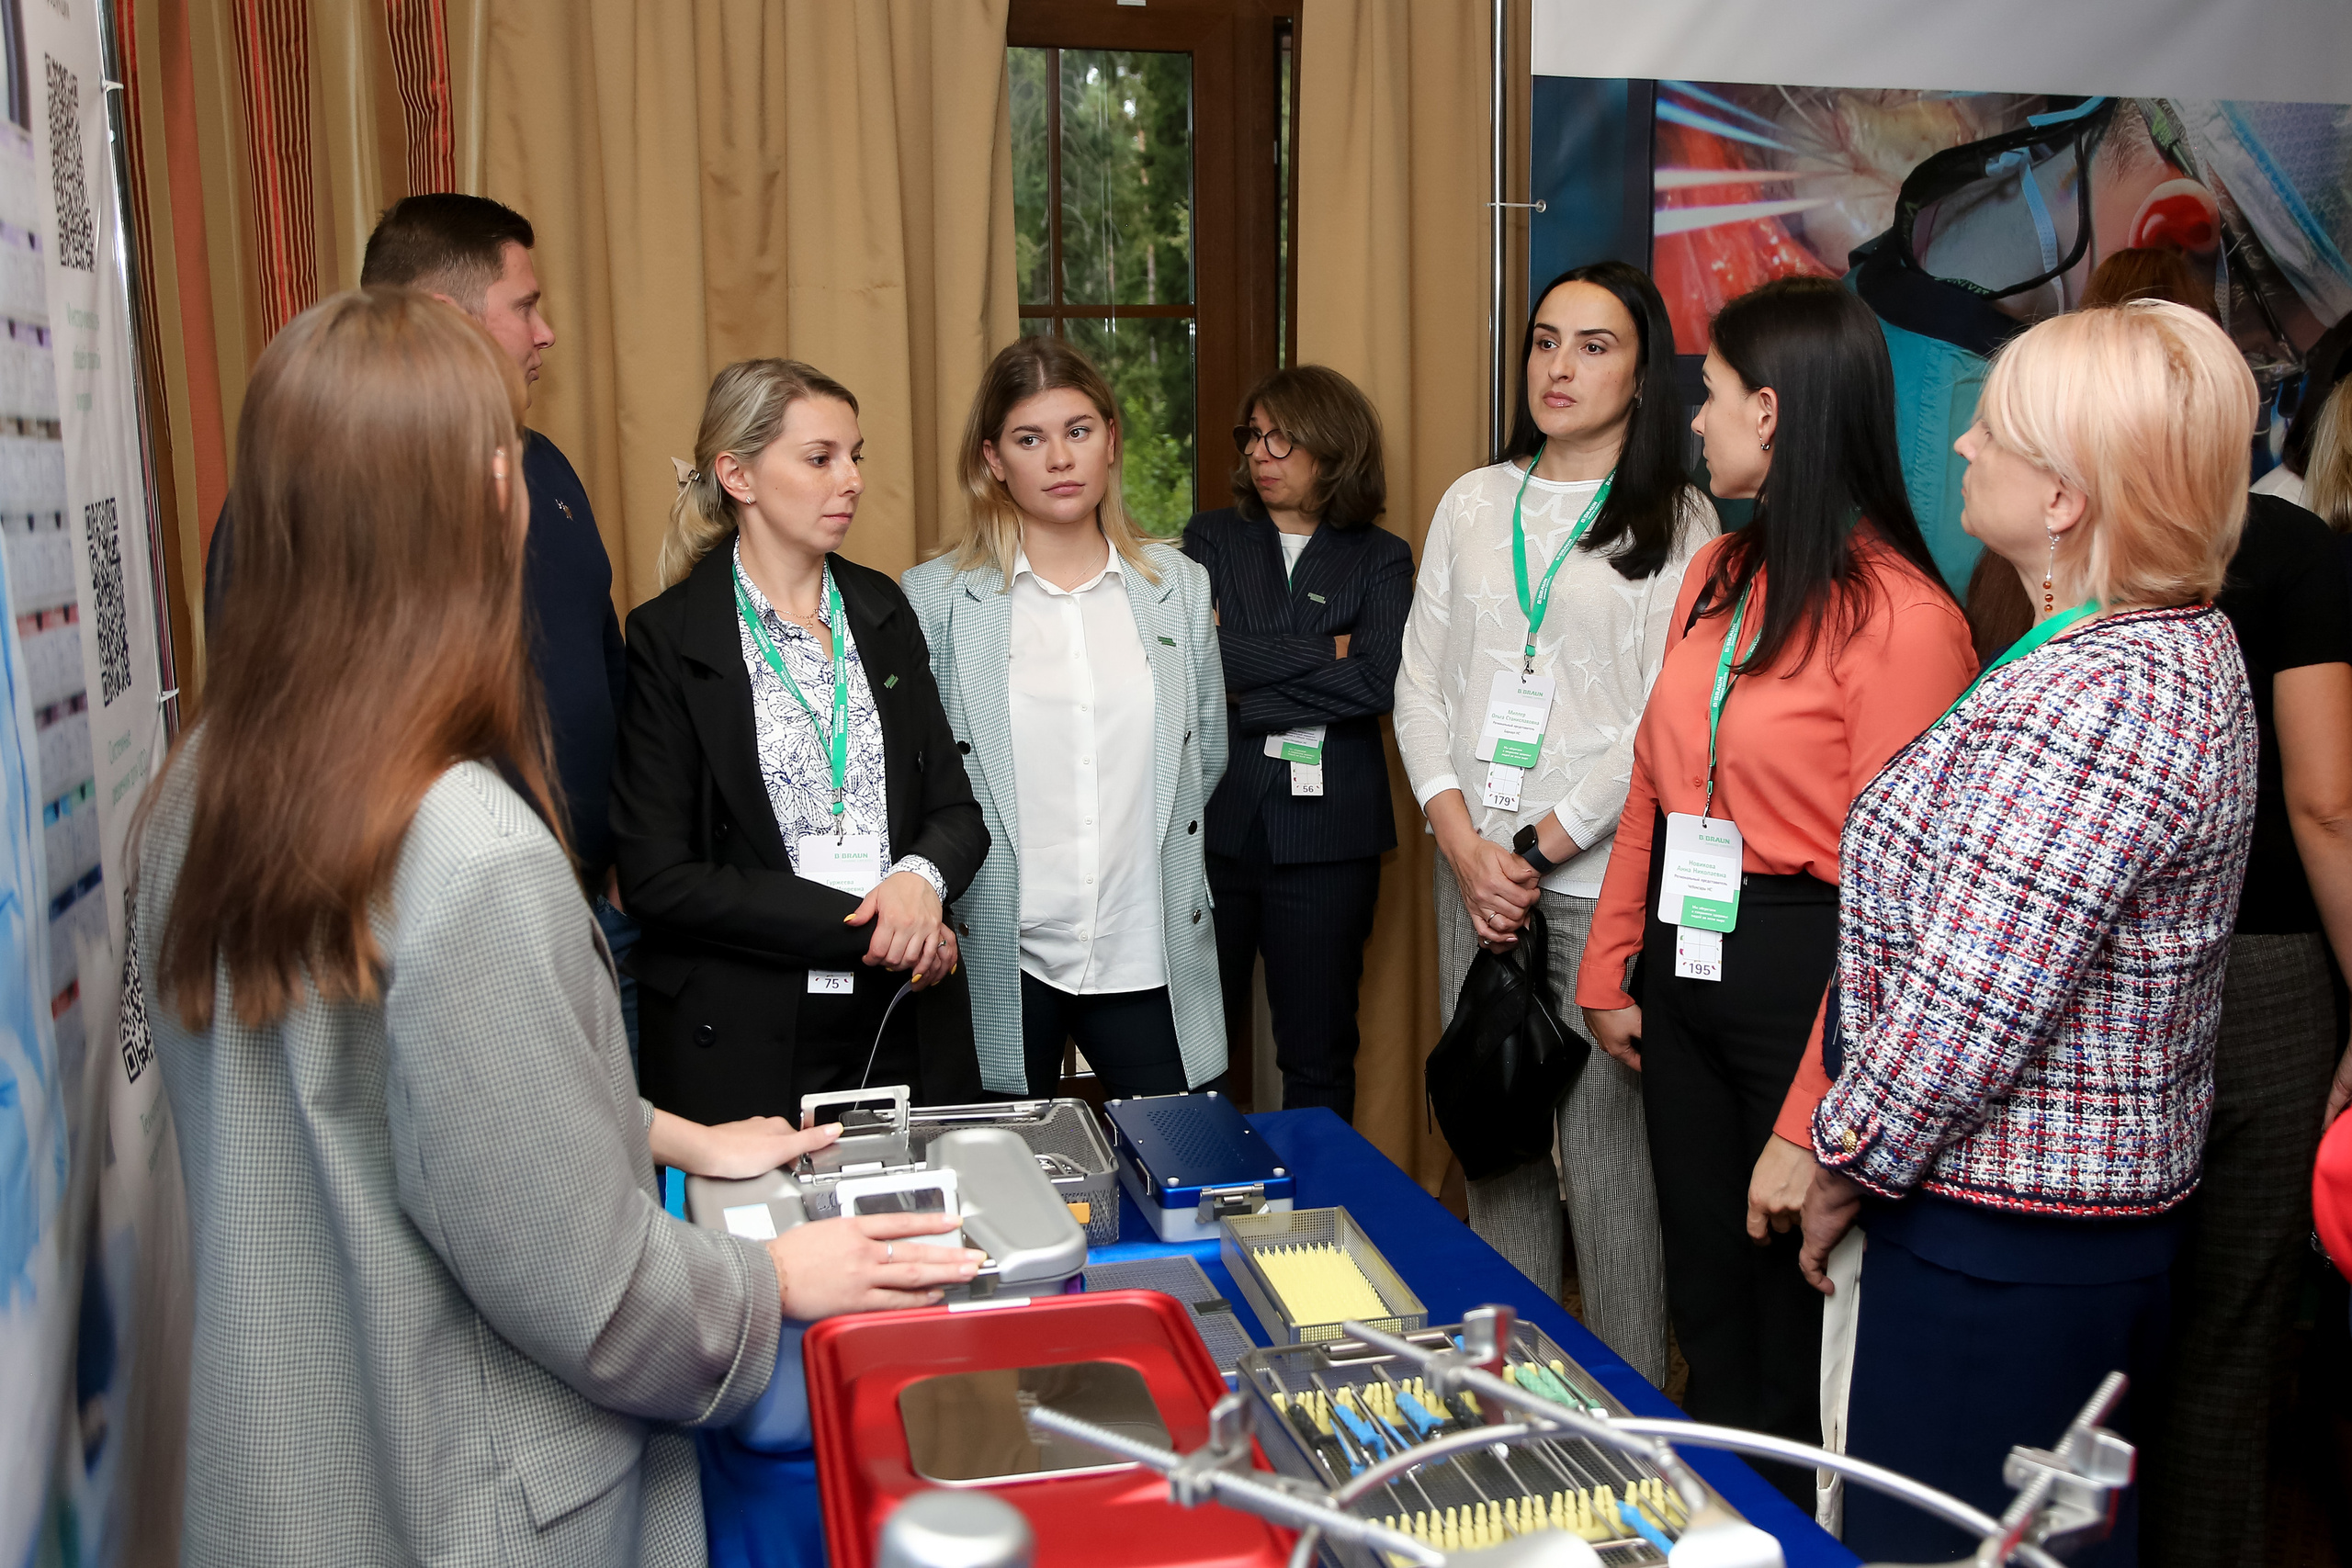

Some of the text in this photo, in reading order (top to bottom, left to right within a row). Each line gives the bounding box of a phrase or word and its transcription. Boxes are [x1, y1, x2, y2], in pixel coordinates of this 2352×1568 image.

[1522, 689, 1544, 697] BRAUN
[1713, 676, 1724, 701] BRAUN
[1494, 795, 1511, 807] 179
[1705, 835, 1730, 844] BRAUN
[1688, 860, 1716, 869] Новикова
[1692, 868, 1727, 878] Николаевна
[1689, 963, 1711, 976] 195
[824, 977, 840, 989] 75
